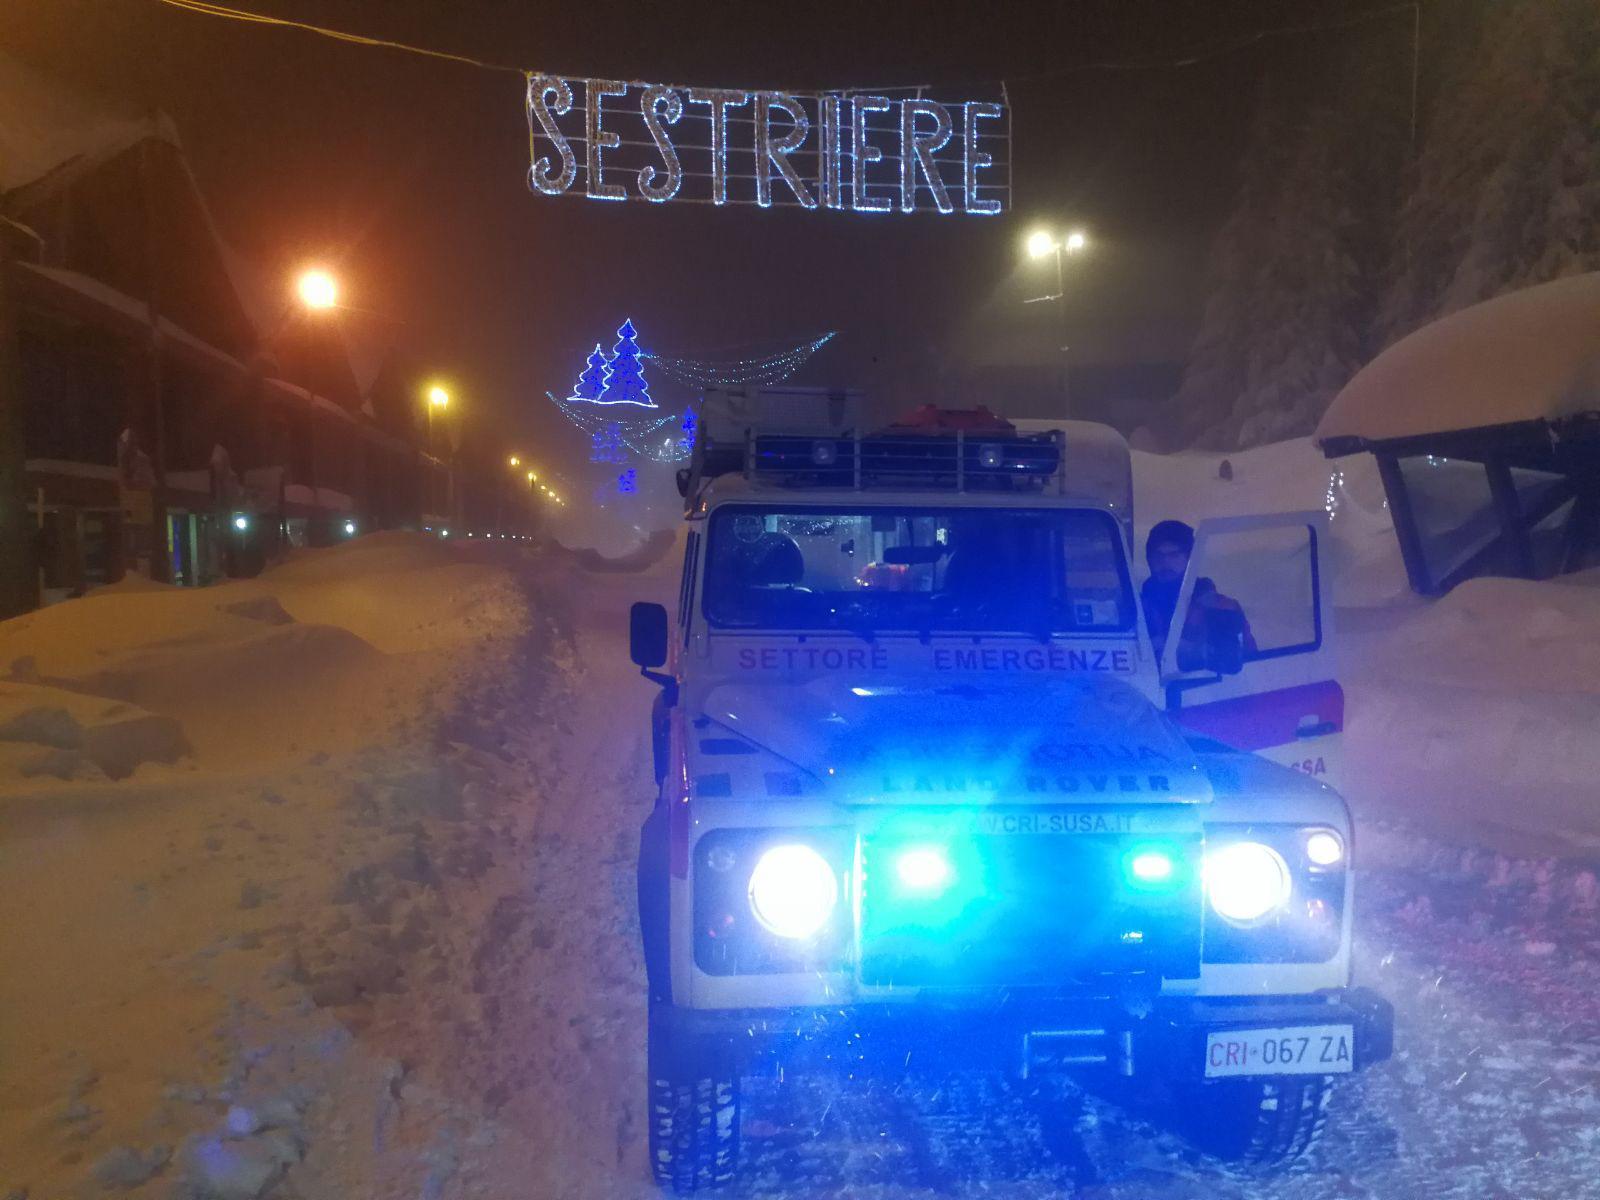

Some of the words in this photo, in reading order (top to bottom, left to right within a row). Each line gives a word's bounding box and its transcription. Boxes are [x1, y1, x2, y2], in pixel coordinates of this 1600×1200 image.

[528, 76, 1001, 214] SESTRIERE
[738, 647, 889, 671] SETTORE
[933, 648, 1131, 672] EMERGENZE
[1025, 775, 1170, 793] ROVER
[1209, 1041, 1248, 1068] CRI
[1262, 1037, 1310, 1065] 067
[1319, 1035, 1350, 1063] ZA
